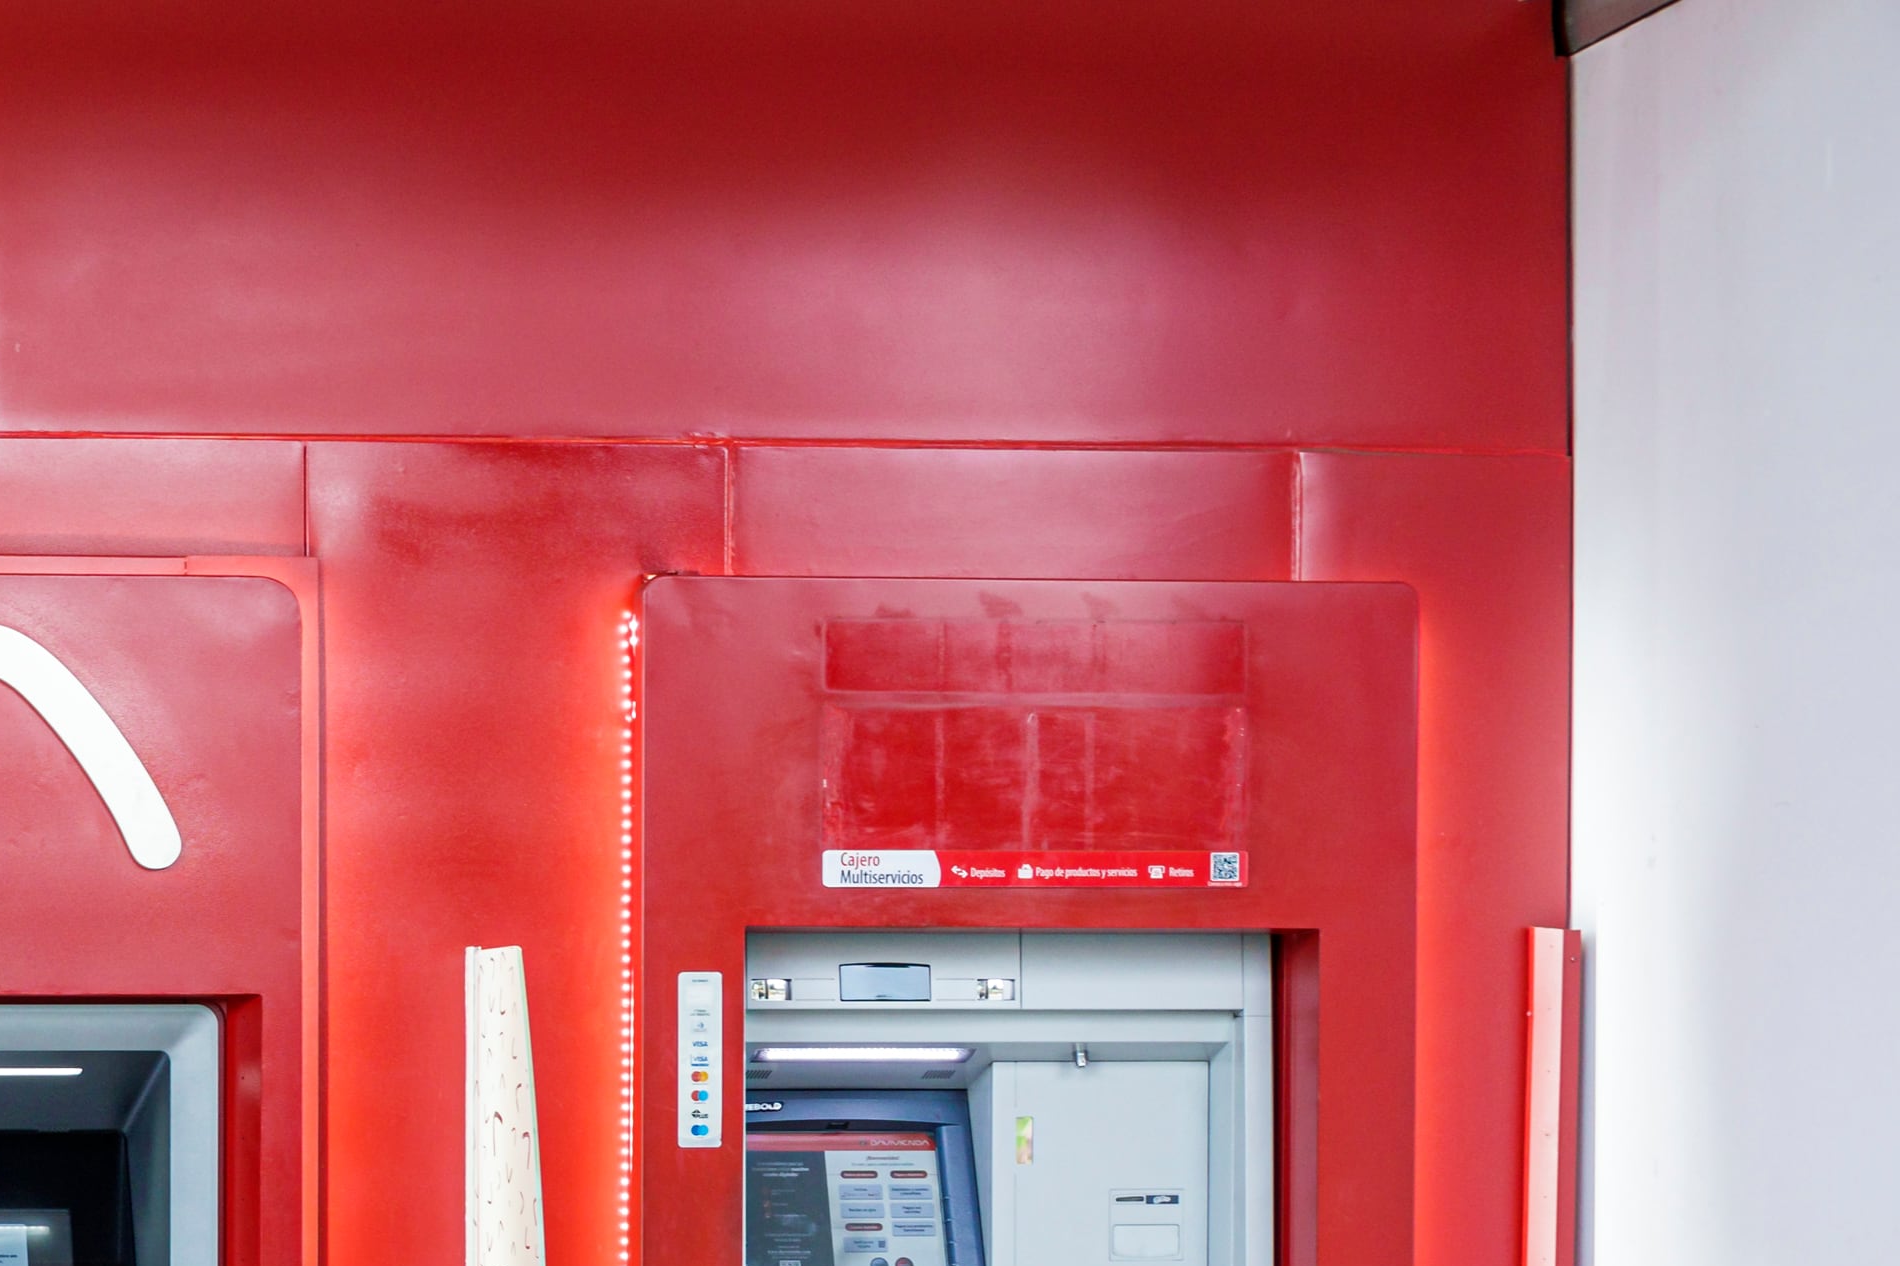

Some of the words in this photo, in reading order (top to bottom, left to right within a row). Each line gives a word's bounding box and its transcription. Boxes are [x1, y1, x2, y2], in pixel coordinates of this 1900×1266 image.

[840, 852, 880, 870] Cajero
[840, 869, 924, 884] Multiservicios
[1035, 866, 1054, 880] Pago
[1054, 867, 1065, 877] de
[1065, 866, 1101, 880] productos
[1107, 866, 1138, 877] servicios
